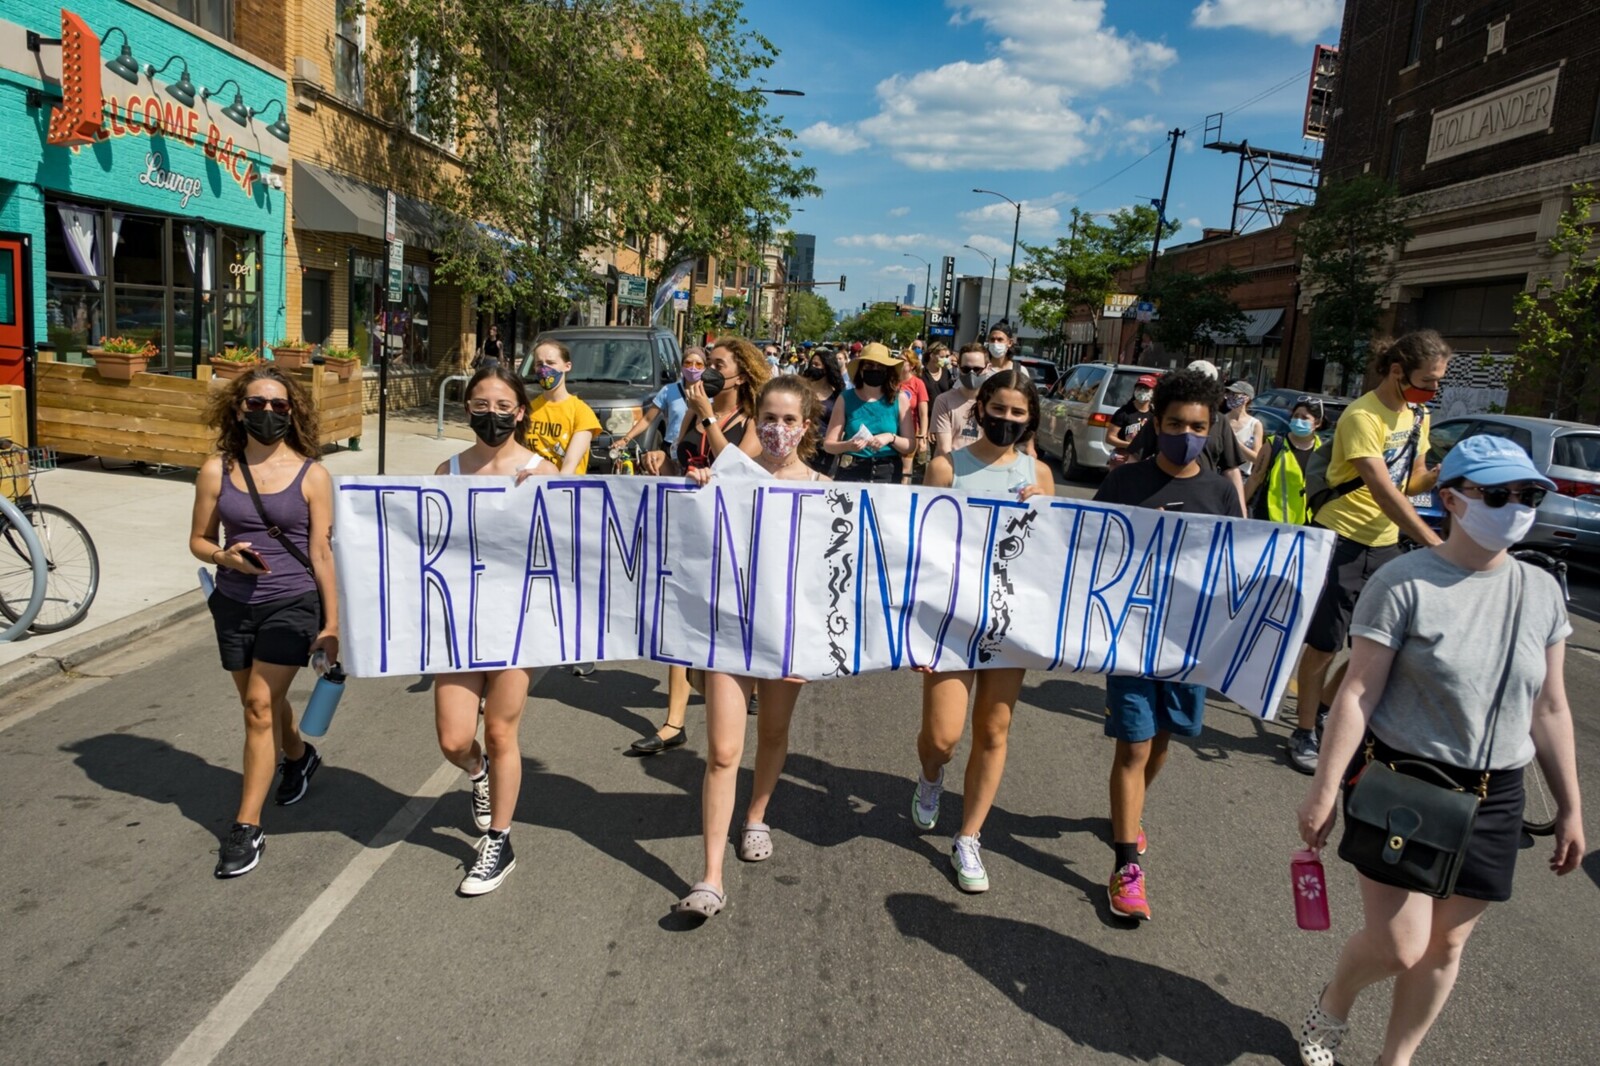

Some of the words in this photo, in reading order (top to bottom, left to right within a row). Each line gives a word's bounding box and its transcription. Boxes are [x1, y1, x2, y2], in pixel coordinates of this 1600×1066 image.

[1432, 85, 1552, 153] HOLLANDER
[139, 152, 202, 207] Lounge
[203, 123, 261, 197] BACK
[943, 257, 953, 313] LIBERTY
[340, 480, 825, 677] TREATMENT
[852, 489, 1029, 675] NOT
[1048, 502, 1305, 718] TRAUMA
